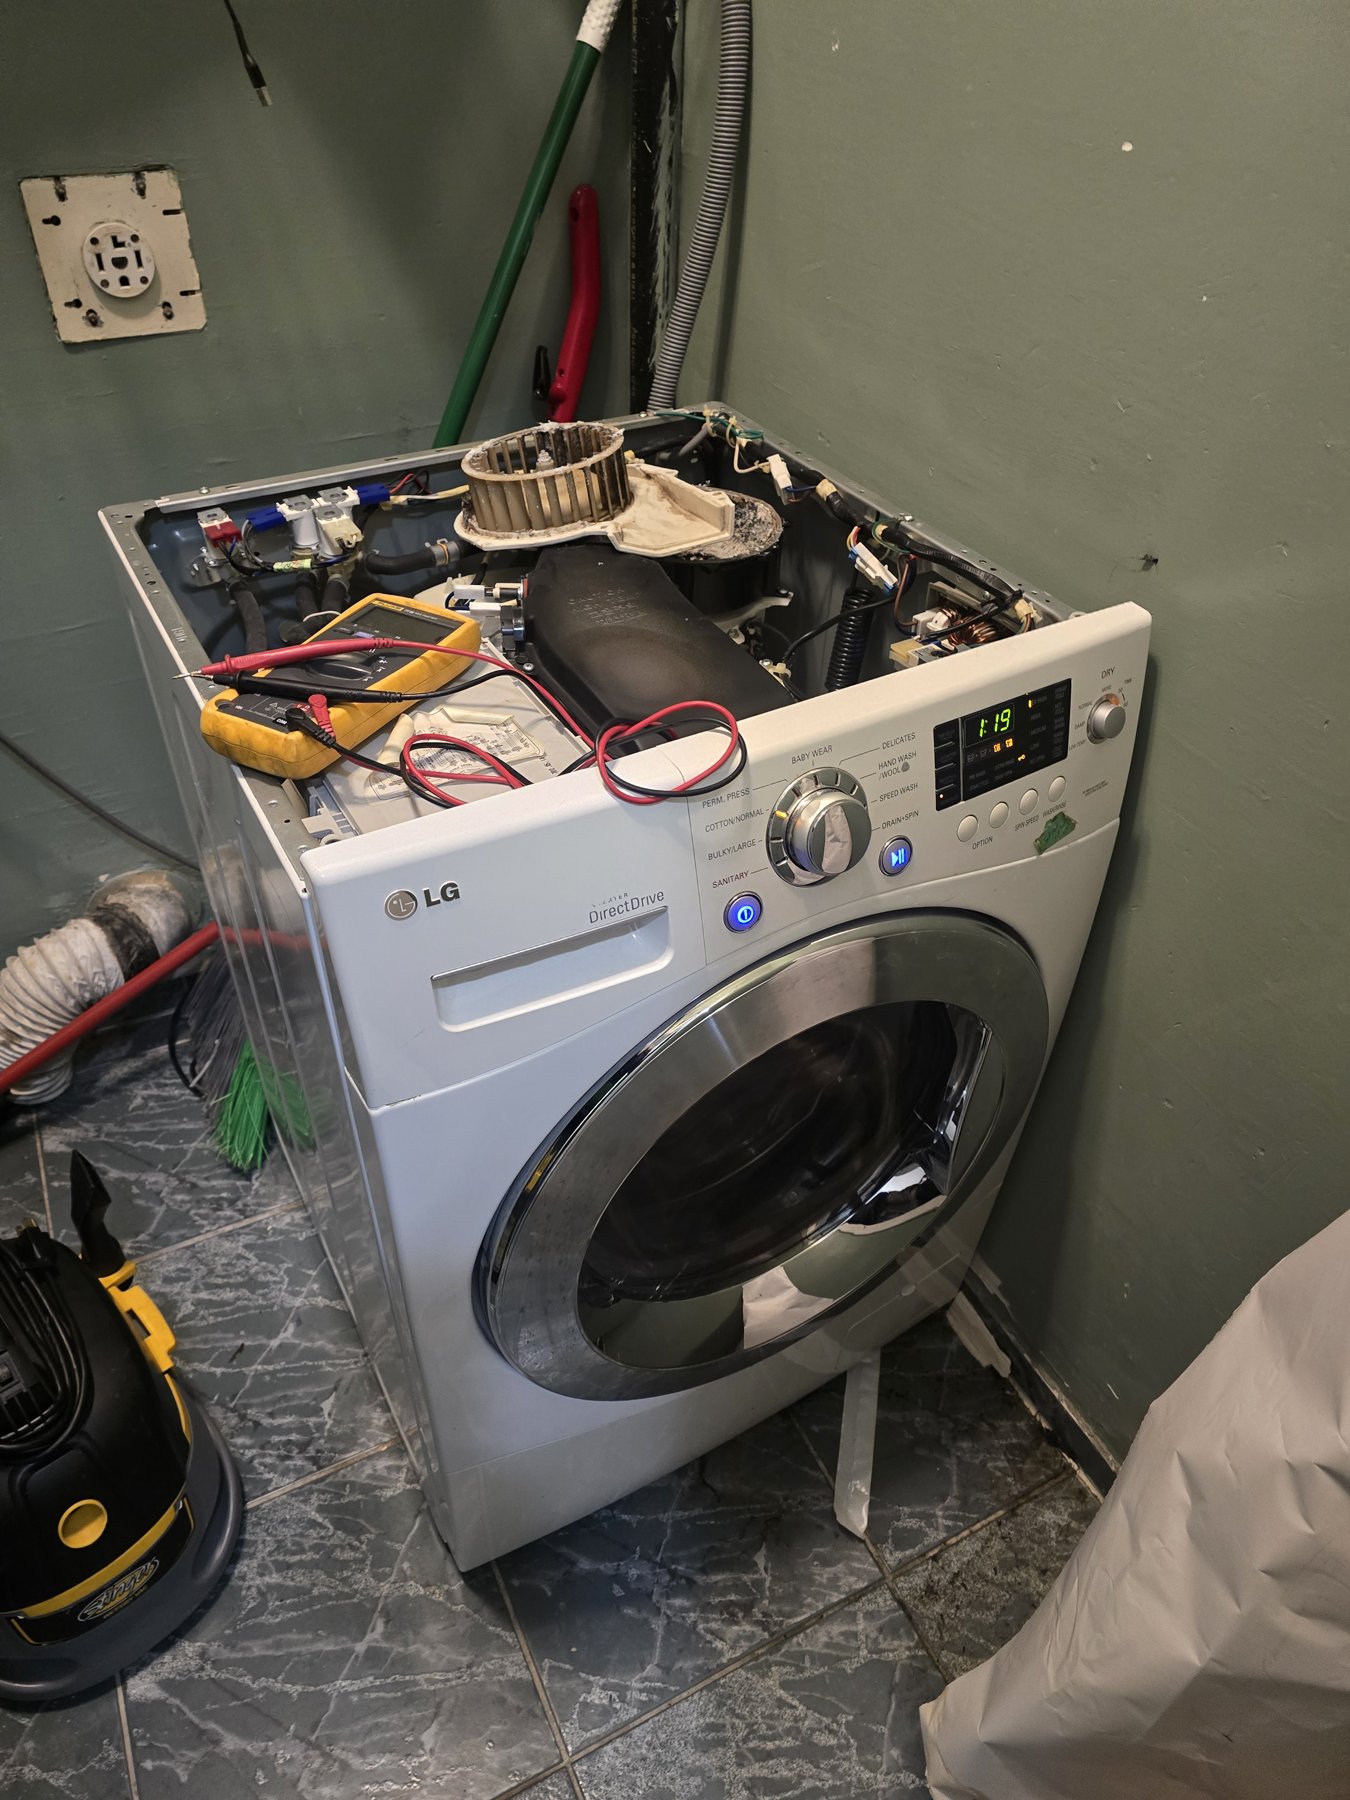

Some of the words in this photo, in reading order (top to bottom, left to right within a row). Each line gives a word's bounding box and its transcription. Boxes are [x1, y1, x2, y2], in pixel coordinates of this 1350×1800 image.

[1101, 667, 1115, 679] DRY
[979, 708, 1011, 738] 1:19
[882, 732, 916, 750] DELICATES
[791, 753, 810, 765] BABY
[811, 745, 833, 757] WEAR
[878, 758, 897, 770] HAND
[897, 750, 917, 763] WASH
[702, 795, 726, 809] PERM.
[726, 787, 750, 801] PRESS
[879, 789, 899, 802] SPEED
[899, 782, 918, 794] WASH
[705, 808, 764, 833] COTTON/NORMAL
[881, 809, 919, 830] DRAIN+SPIN
[1014, 820, 1025, 832] SPIN
[1025, 814, 1039, 827] SPEED
[708, 838, 757, 861] BULKY/LARGE
[972, 836, 993, 850] OPTION
[712, 870, 749, 889] SANITARY
[423, 881, 461, 908] LG
